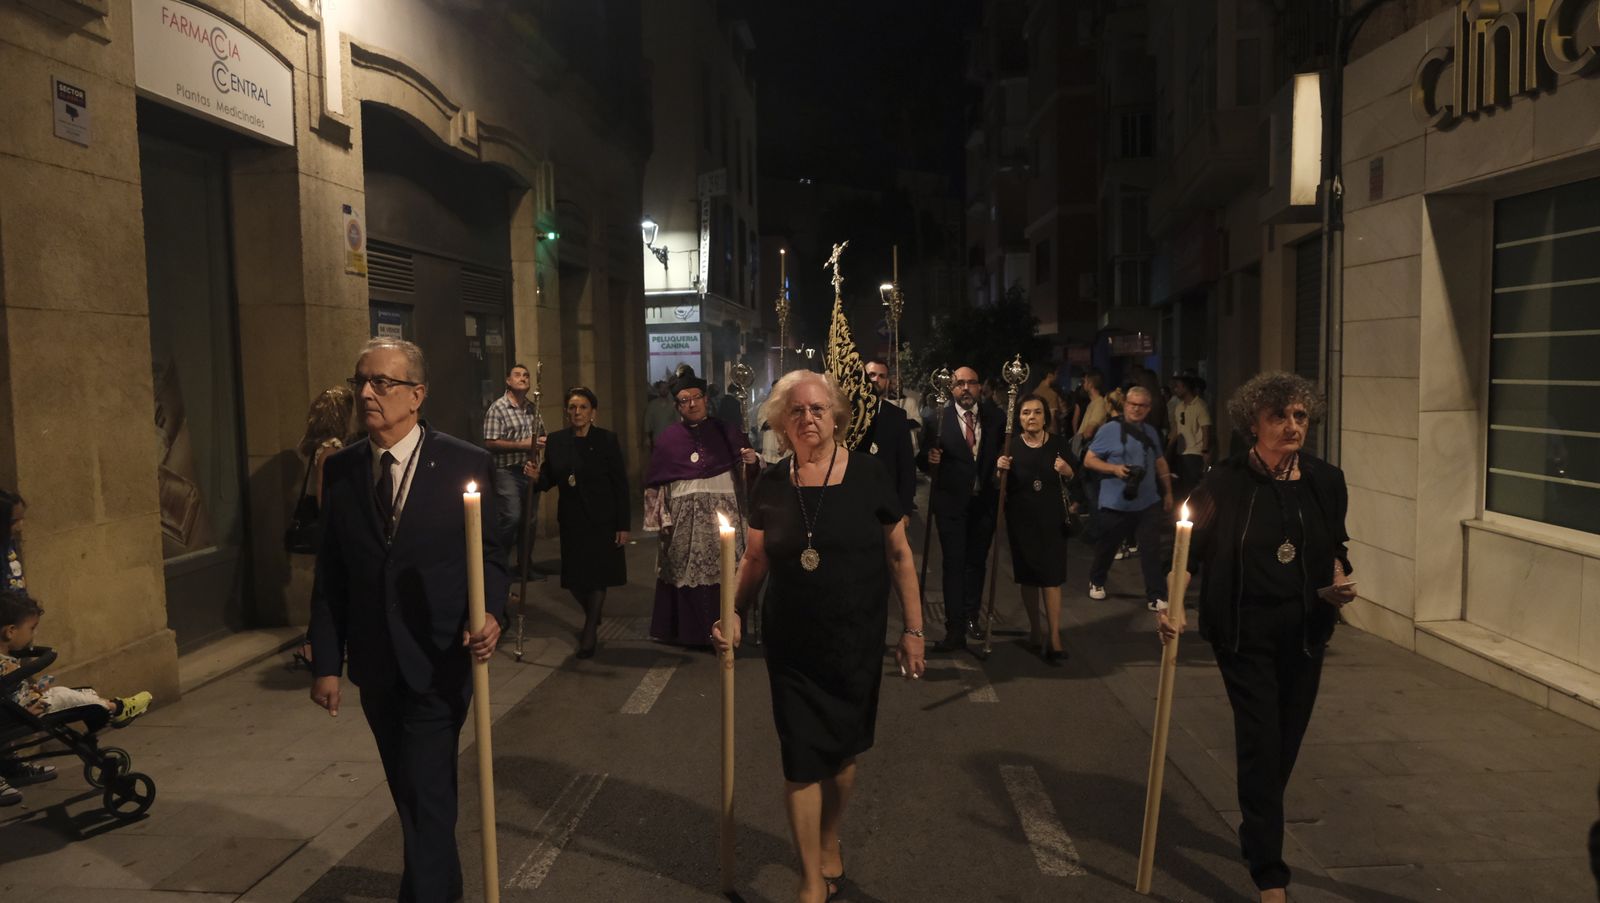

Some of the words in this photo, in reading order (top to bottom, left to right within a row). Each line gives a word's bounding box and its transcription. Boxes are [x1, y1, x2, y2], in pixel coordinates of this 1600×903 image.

[162, 6, 241, 61] FARMACIA
[176, 83, 211, 108] Plantas
[216, 101, 265, 129] Medicinales
[211, 60, 272, 107] CENTRAL
